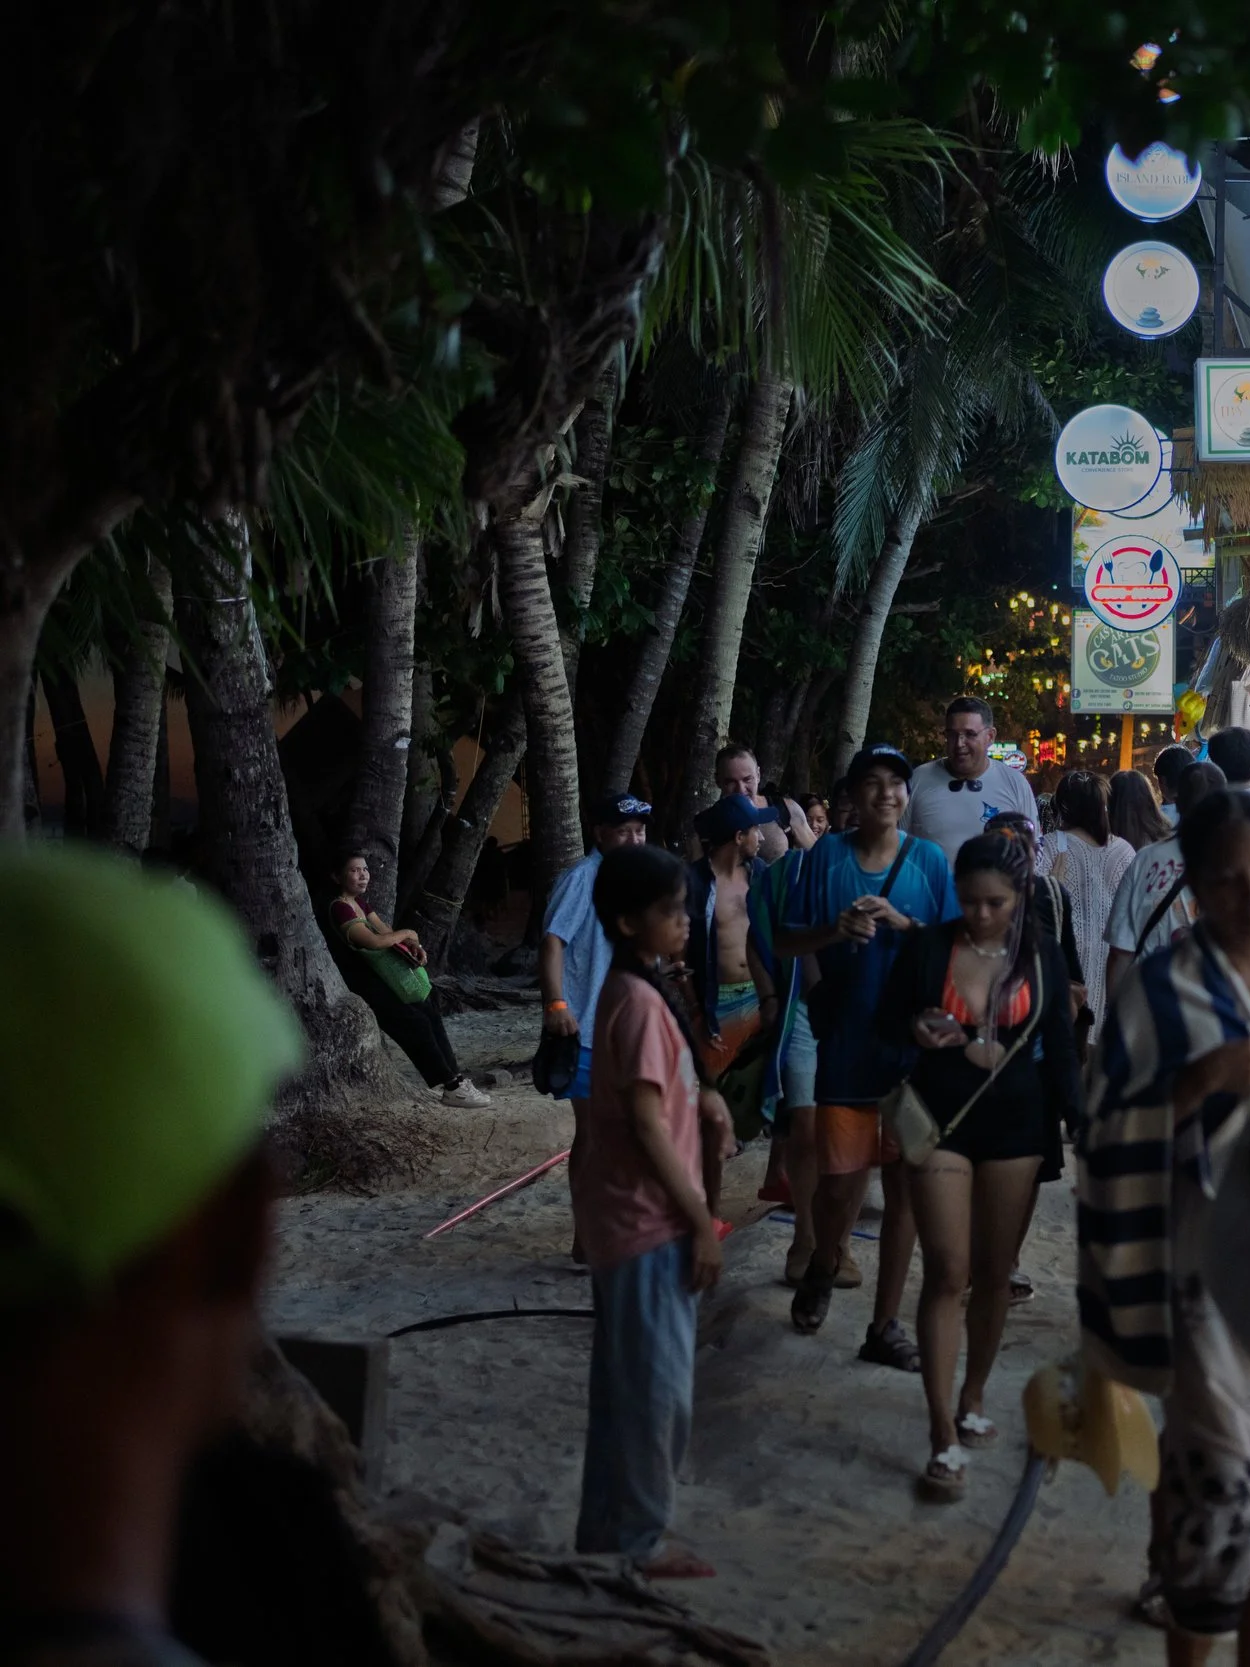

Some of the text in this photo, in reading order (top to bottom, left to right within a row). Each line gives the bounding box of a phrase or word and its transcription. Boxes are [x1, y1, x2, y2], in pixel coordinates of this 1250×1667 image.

[1116, 172, 1159, 185] ISLAND
[1065, 450, 1150, 465] KATABOM
[1089, 629, 1160, 672] CATS
